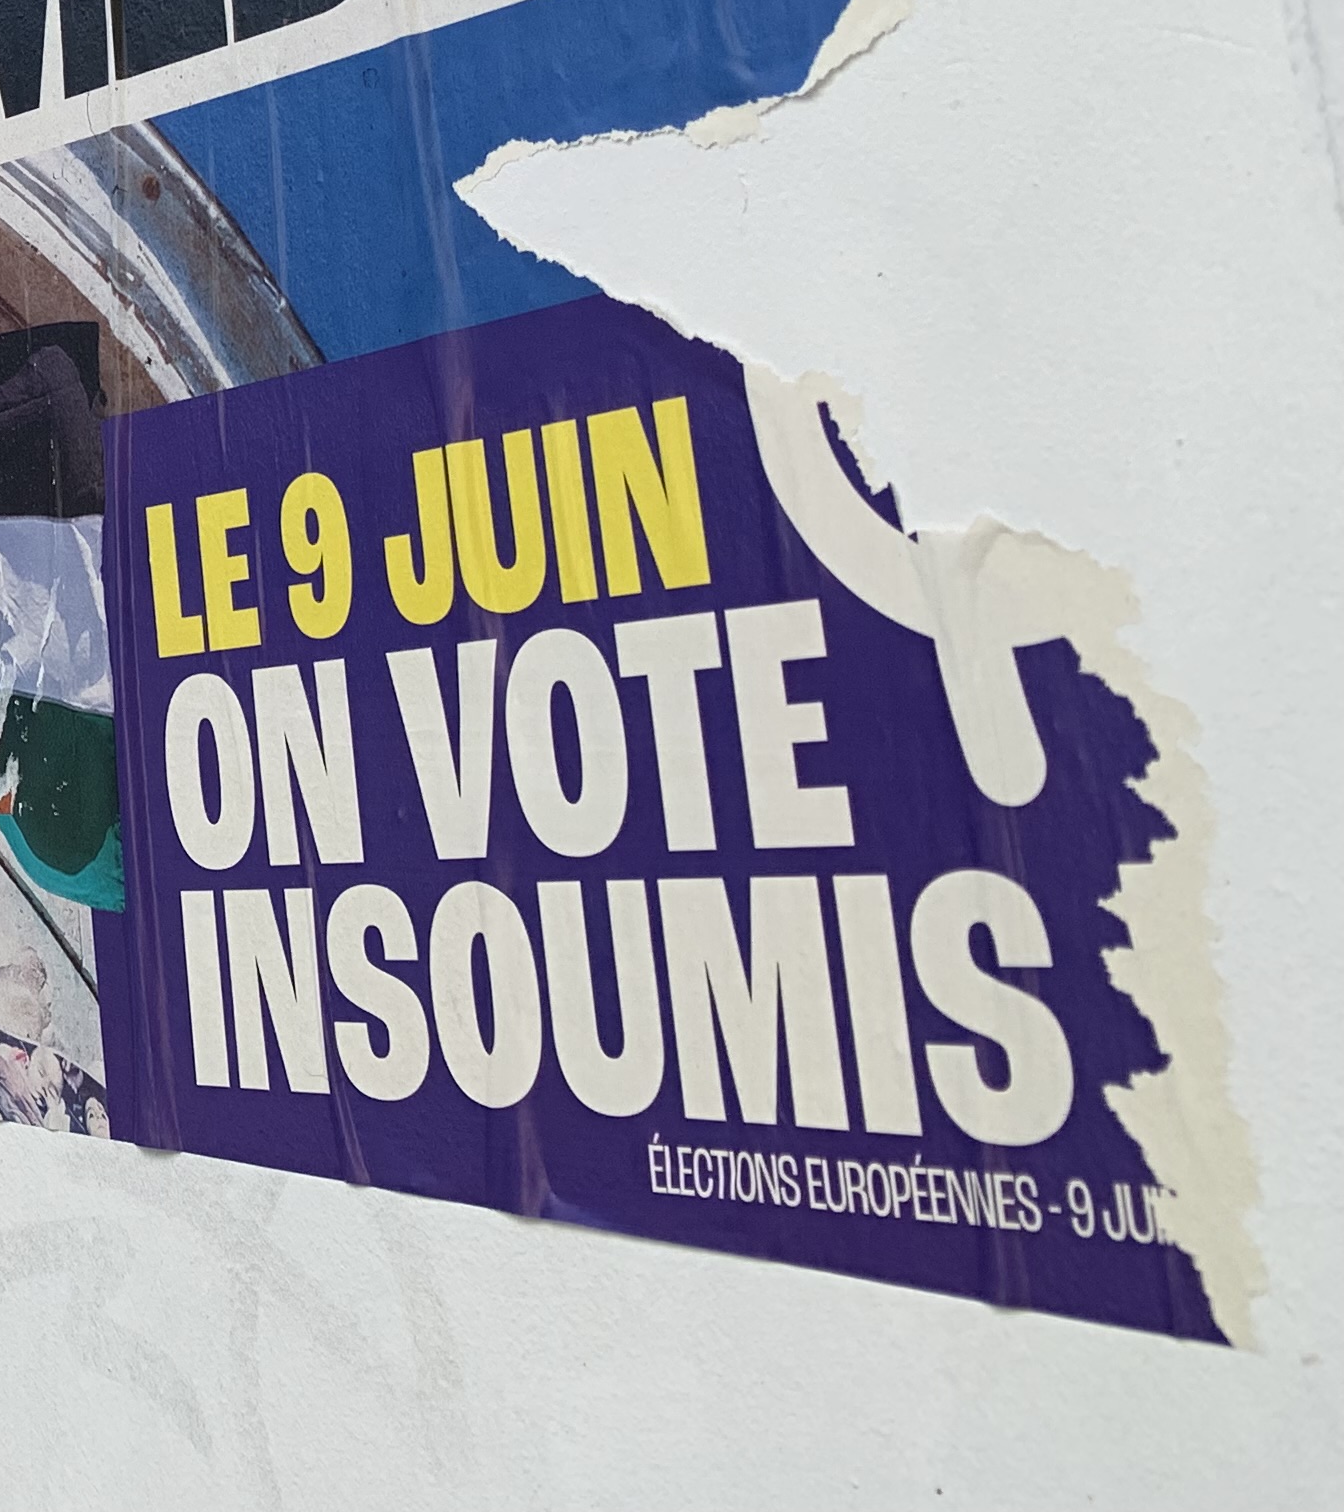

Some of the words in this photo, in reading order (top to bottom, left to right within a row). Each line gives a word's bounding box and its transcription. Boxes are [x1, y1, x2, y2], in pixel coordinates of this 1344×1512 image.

[144, 488, 264, 659] LE
[278, 472, 354, 639] 9
[383, 396, 712, 626] JUIN
[164, 658, 364, 871] ON
[387, 598, 856, 862] VOTE
[180, 869, 1076, 1149] INSOUMIS
[647, 1134, 803, 1209] ÉLECTIONS
[805, 1153, 1044, 1233] EUROPÉENNES
[1067, 1178, 1096, 1240] 9
